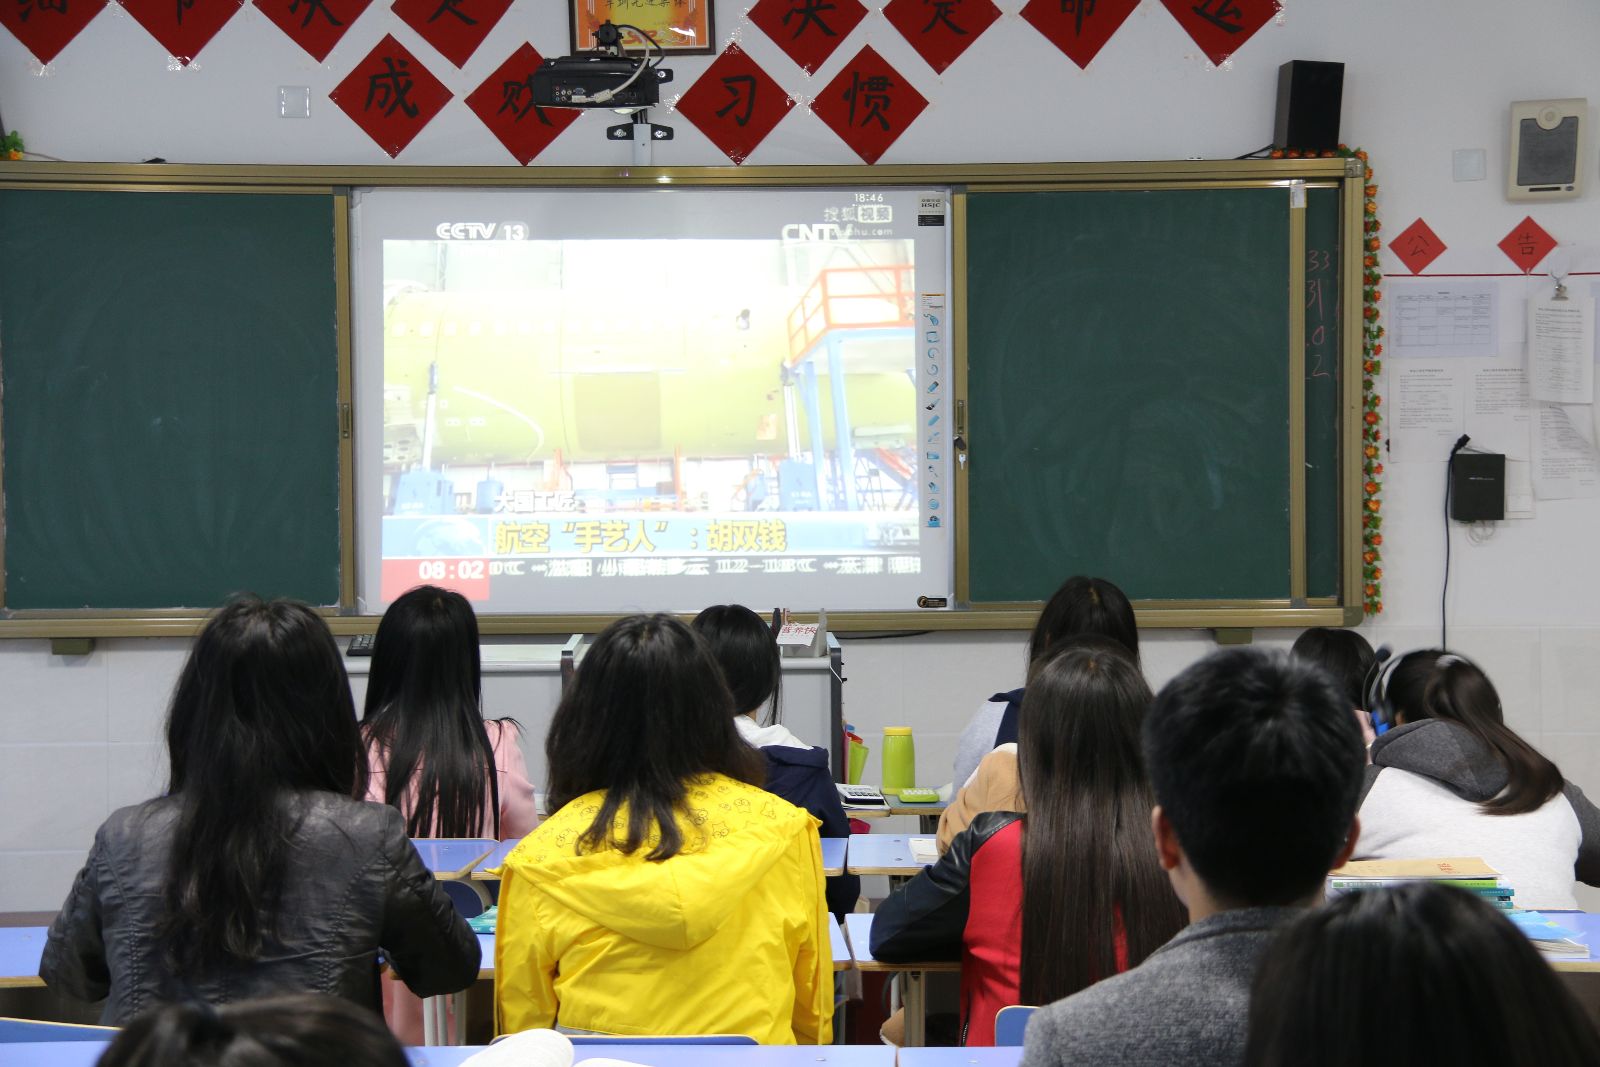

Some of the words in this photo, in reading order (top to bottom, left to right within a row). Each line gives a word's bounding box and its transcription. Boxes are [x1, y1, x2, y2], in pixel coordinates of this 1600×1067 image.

[854, 193, 884, 202] 18:46
[436, 222, 497, 239] CCTV
[503, 224, 525, 240] 13
[782, 223, 854, 241] CNTV
[418, 560, 485, 580] 08:02
